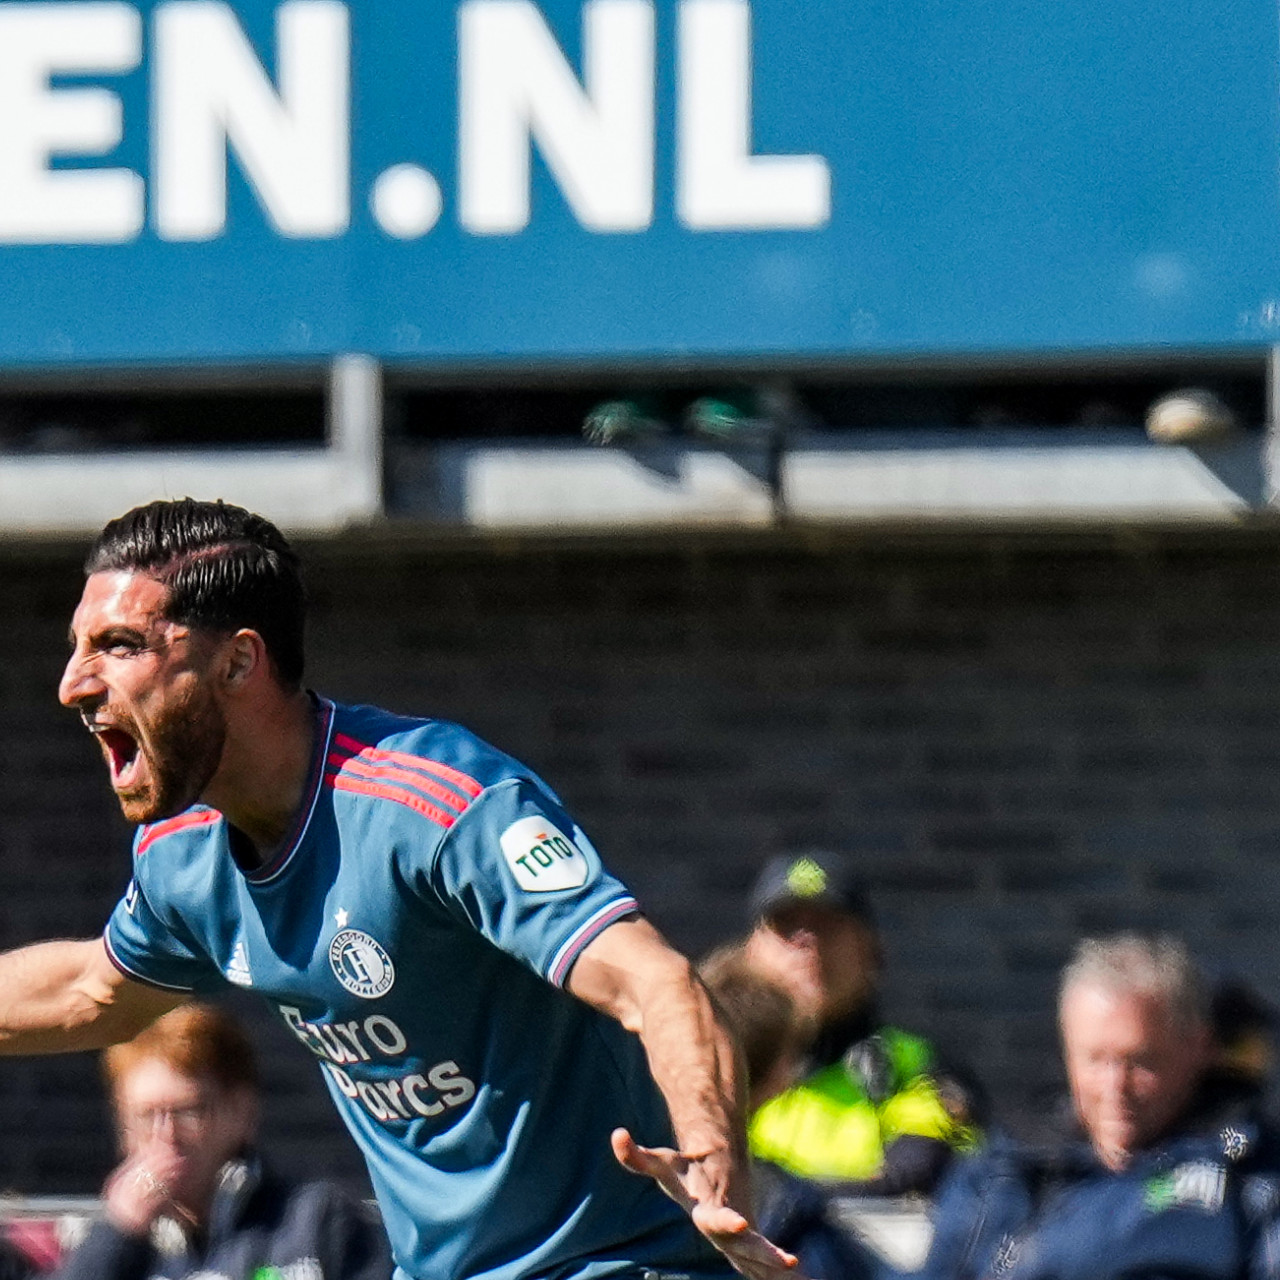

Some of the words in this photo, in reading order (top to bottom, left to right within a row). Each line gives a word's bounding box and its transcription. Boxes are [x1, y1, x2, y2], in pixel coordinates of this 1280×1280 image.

[515, 836, 574, 877] TOTO
[279, 1004, 407, 1064] Euro
[325, 1060, 476, 1121] Parcs
